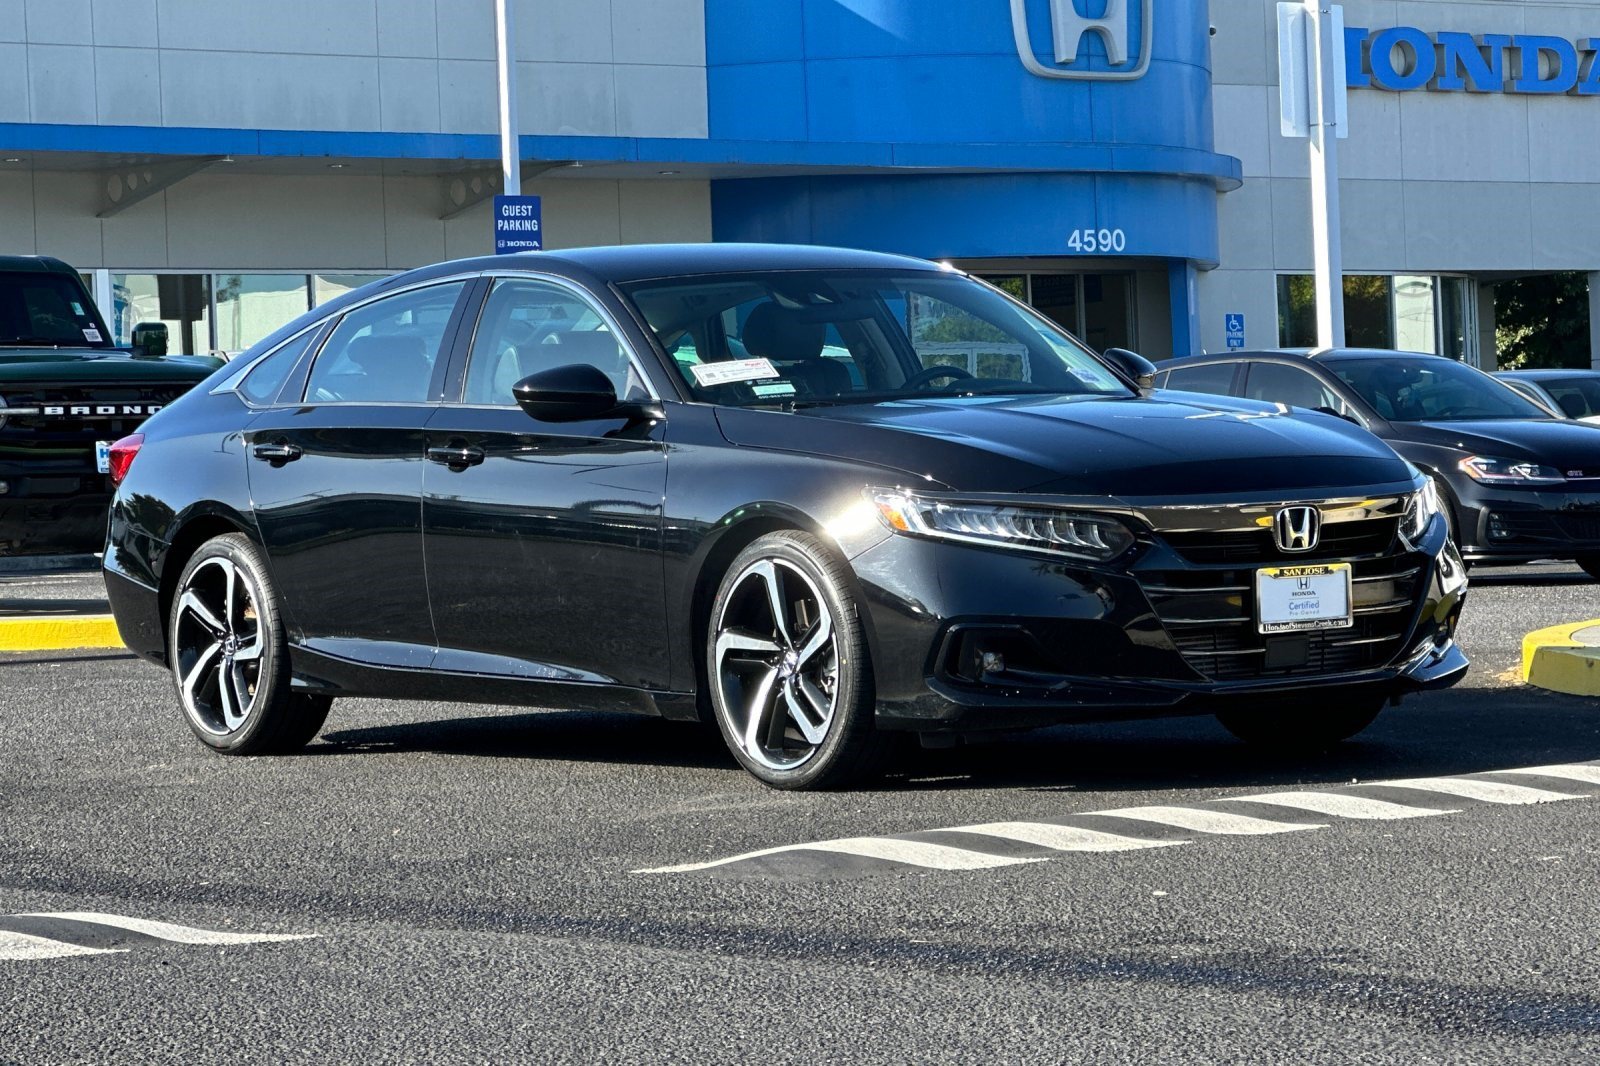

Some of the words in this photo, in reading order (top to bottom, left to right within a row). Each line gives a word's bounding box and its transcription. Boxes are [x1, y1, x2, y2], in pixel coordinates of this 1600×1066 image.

[502, 204, 532, 216] GUEST
[497, 219, 538, 231] PARKING
[1067, 228, 1126, 252] 4590
[1283, 568, 1302, 577] SAN
[1303, 566, 1326, 575] JOSE
[1289, 600, 1320, 610] Certified
